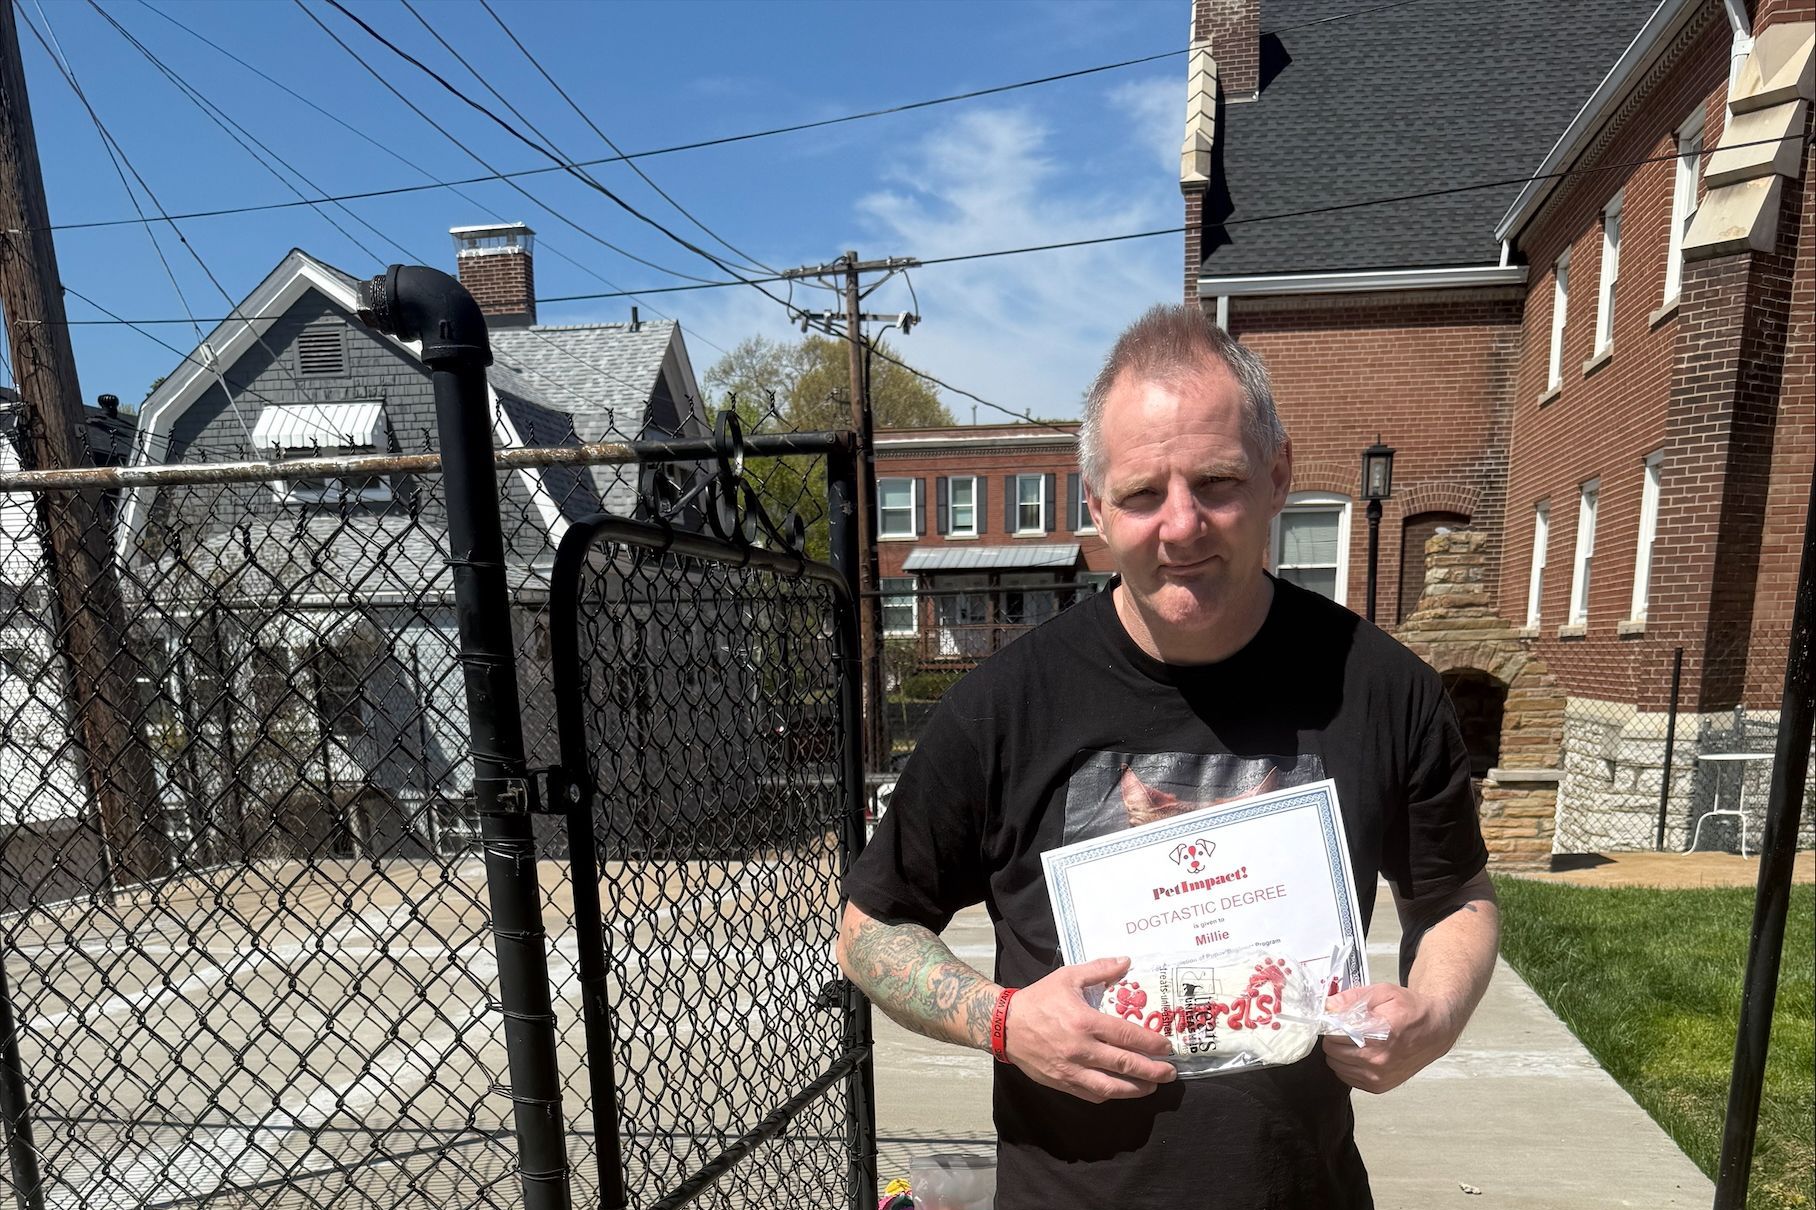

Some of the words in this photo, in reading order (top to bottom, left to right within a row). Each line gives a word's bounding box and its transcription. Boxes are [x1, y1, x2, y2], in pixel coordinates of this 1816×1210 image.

[1153, 866, 1248, 901] PetImpact!
[1126, 901, 1217, 935] DOGTASTIC
[1220, 884, 1287, 911] DEGREE
[1200, 919, 1217, 929] given
[1195, 930, 1230, 946] Millie
[1255, 937, 1281, 947] Program
[994, 1009, 1004, 1038] DON'T
